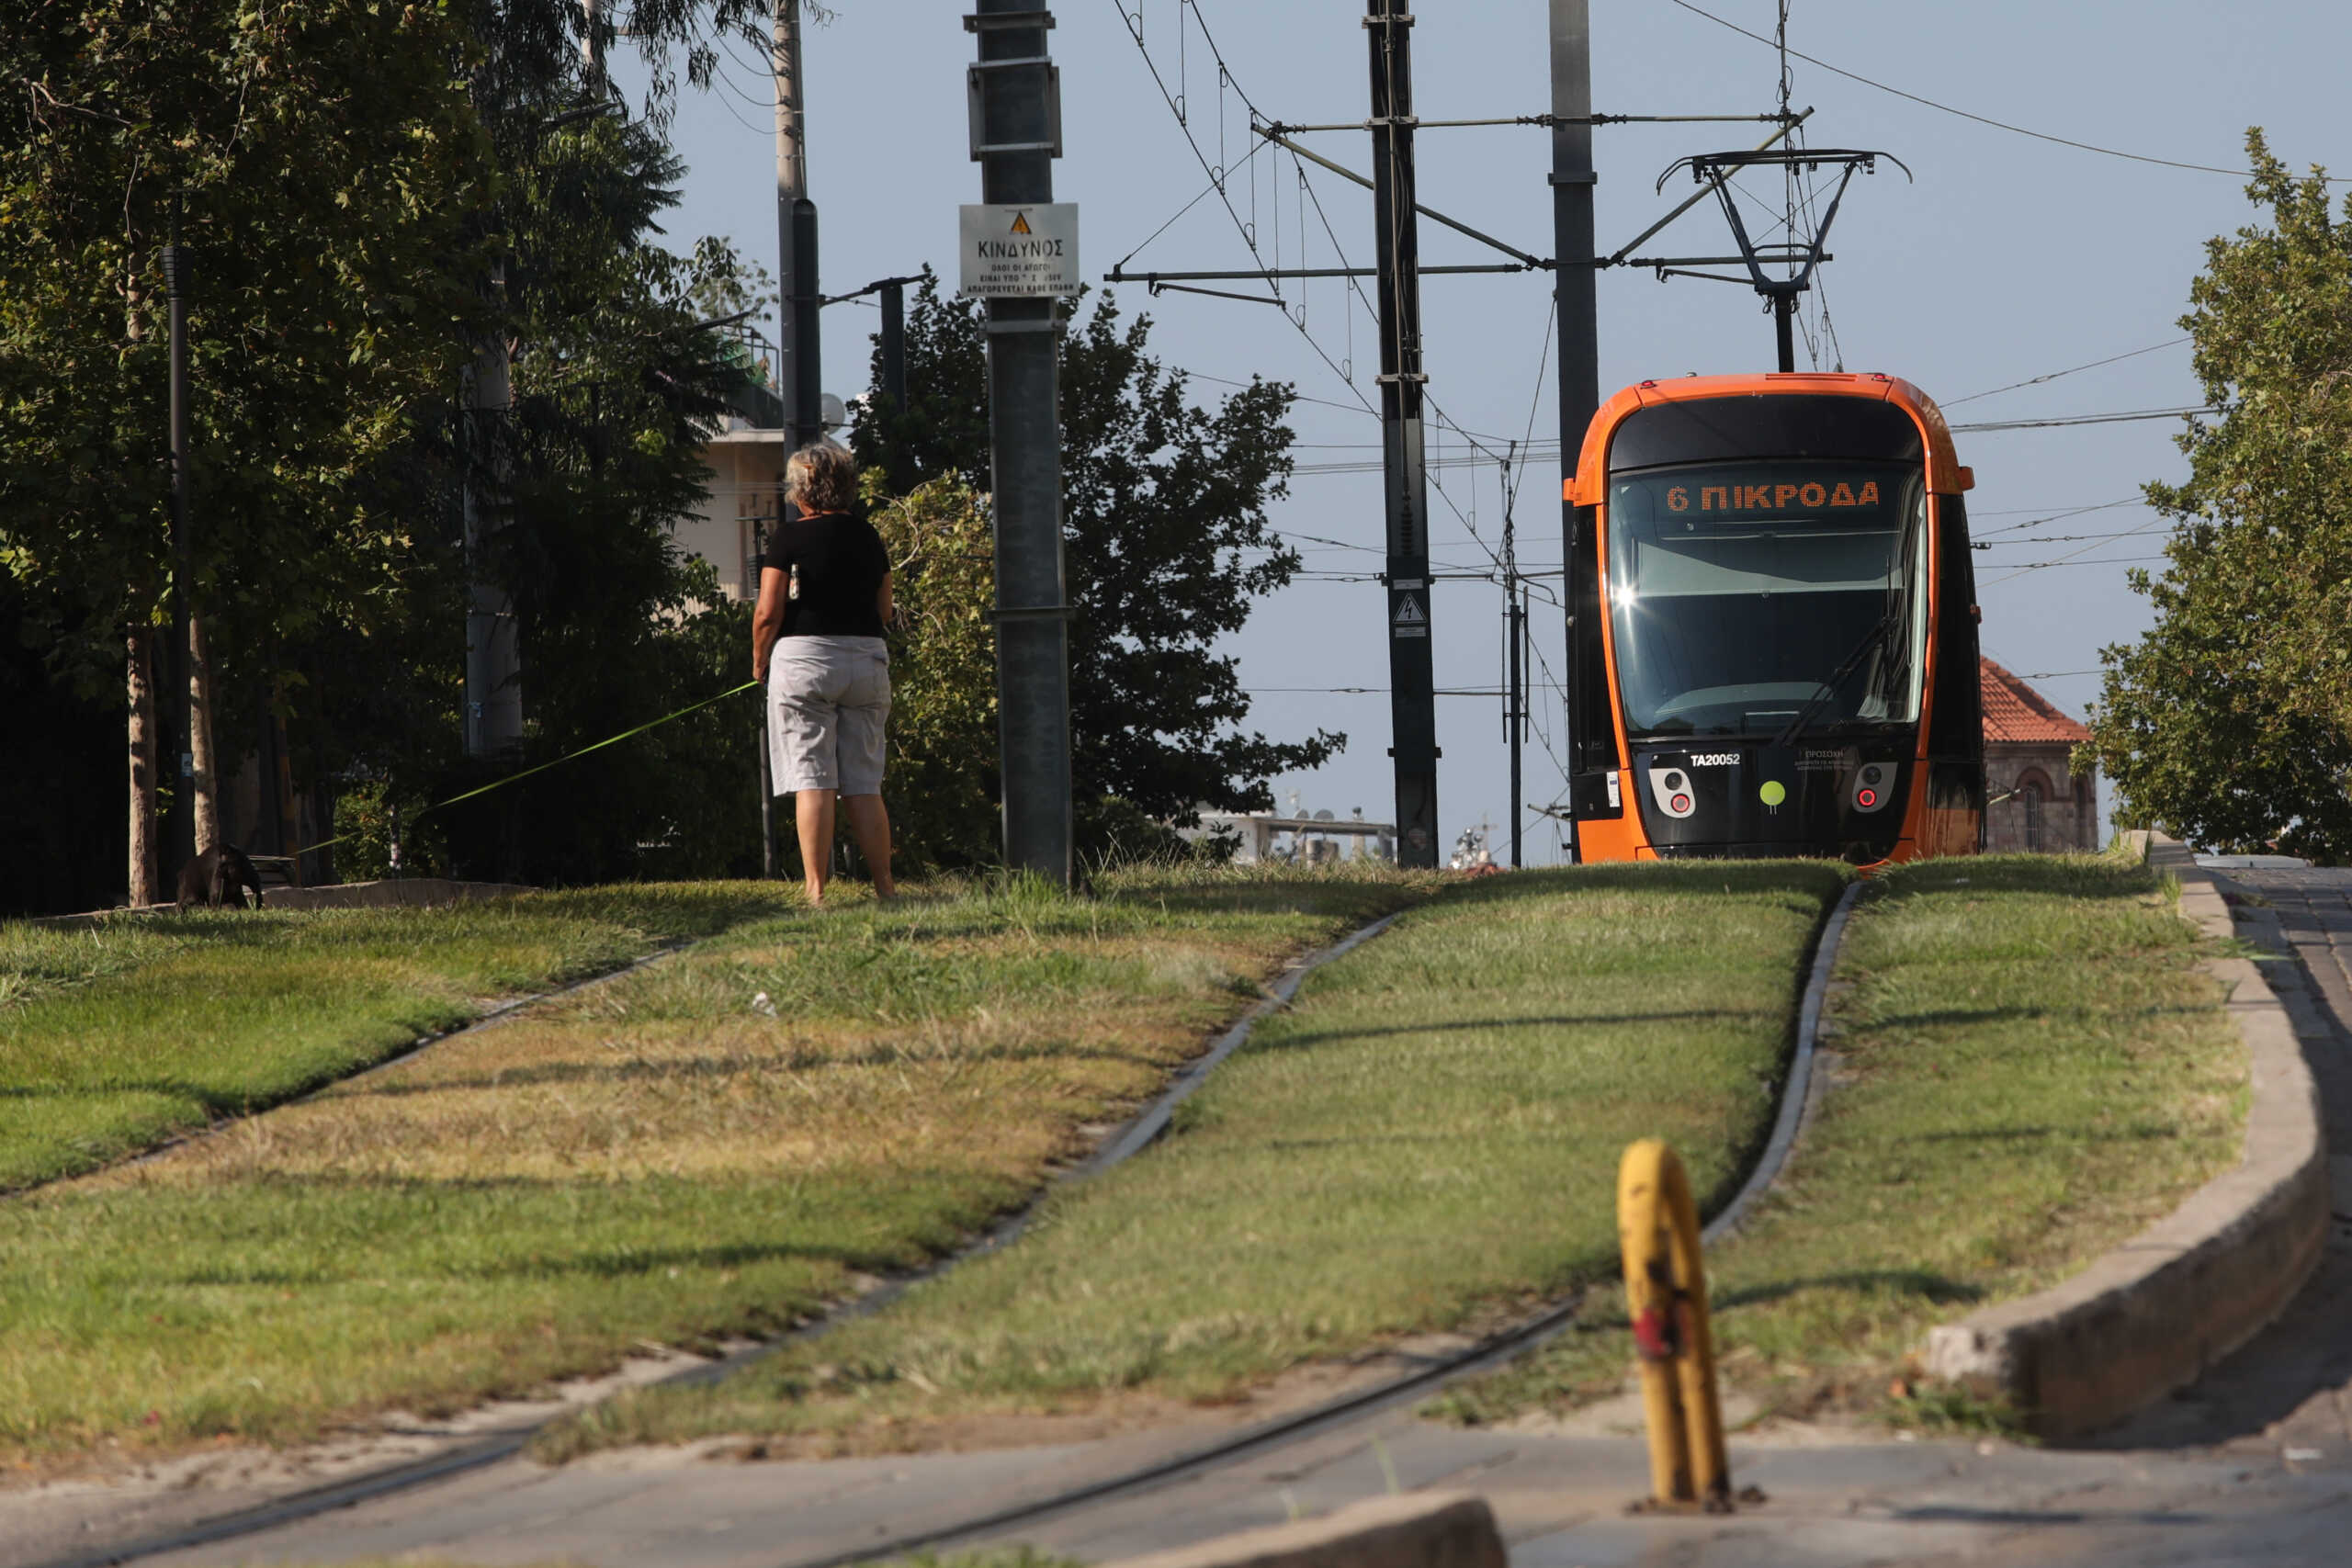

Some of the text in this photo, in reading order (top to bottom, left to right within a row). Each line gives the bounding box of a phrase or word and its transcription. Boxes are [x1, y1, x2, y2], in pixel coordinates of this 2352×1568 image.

[978, 239, 1063, 258] ΚΙΝΔΥΝΟΣ
[1667, 481, 1879, 512] 6 ΠΙΚΡΟΔΑ
[1690, 753, 1740, 767] TA20052
[1804, 749, 1845, 758] ΠΡΟΣΟΧΗ
